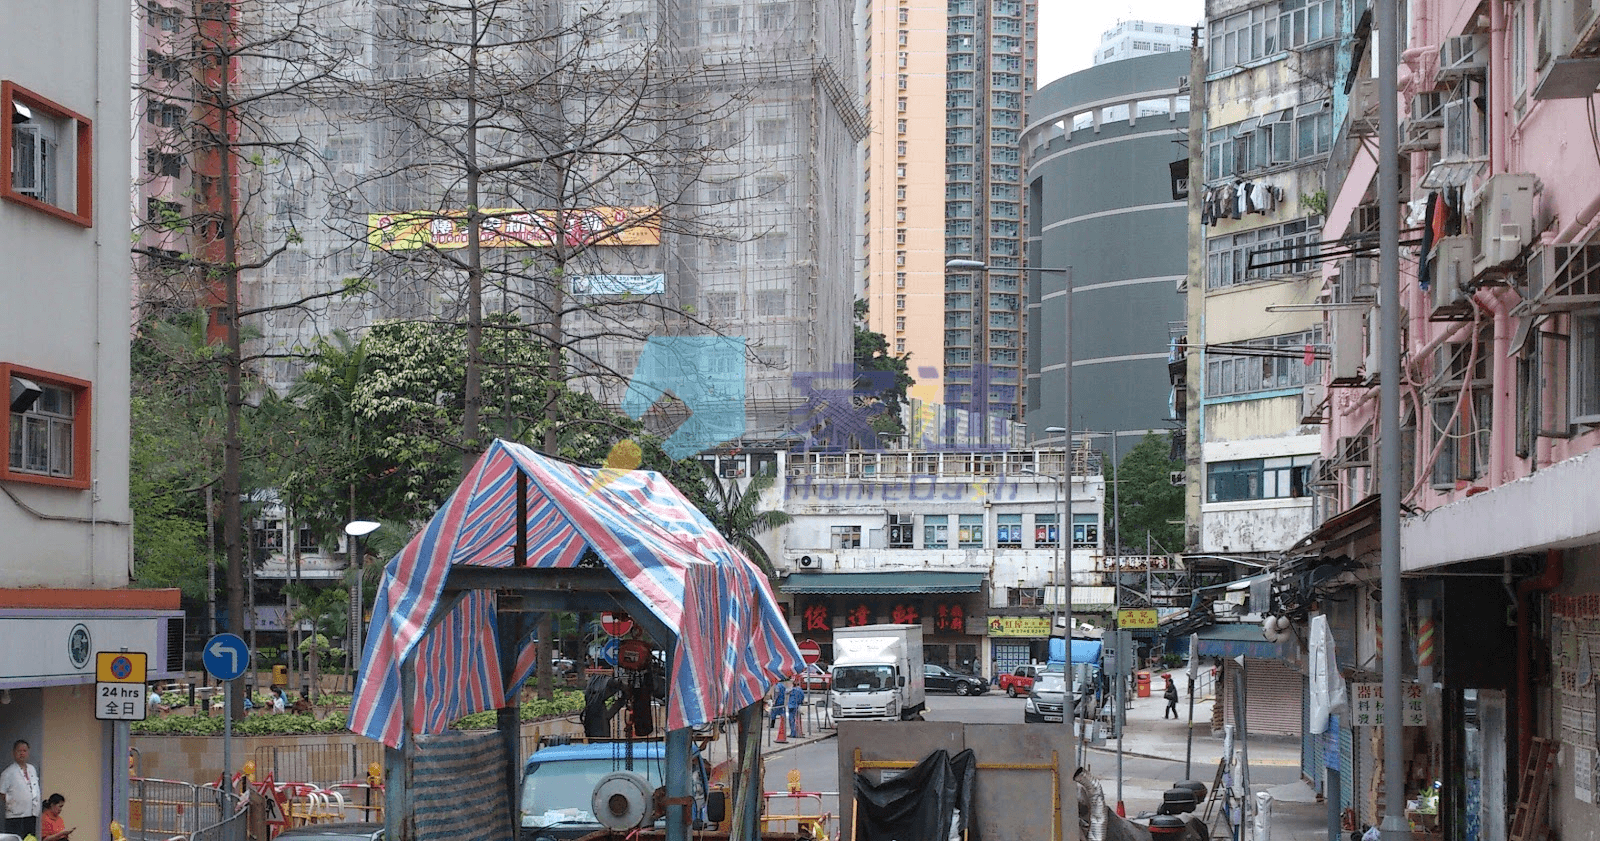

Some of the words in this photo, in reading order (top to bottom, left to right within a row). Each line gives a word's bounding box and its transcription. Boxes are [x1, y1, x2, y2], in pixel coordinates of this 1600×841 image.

[102, 687, 117, 697] 24
[121, 686, 139, 697] hrs
[105, 701, 135, 715] 全日
